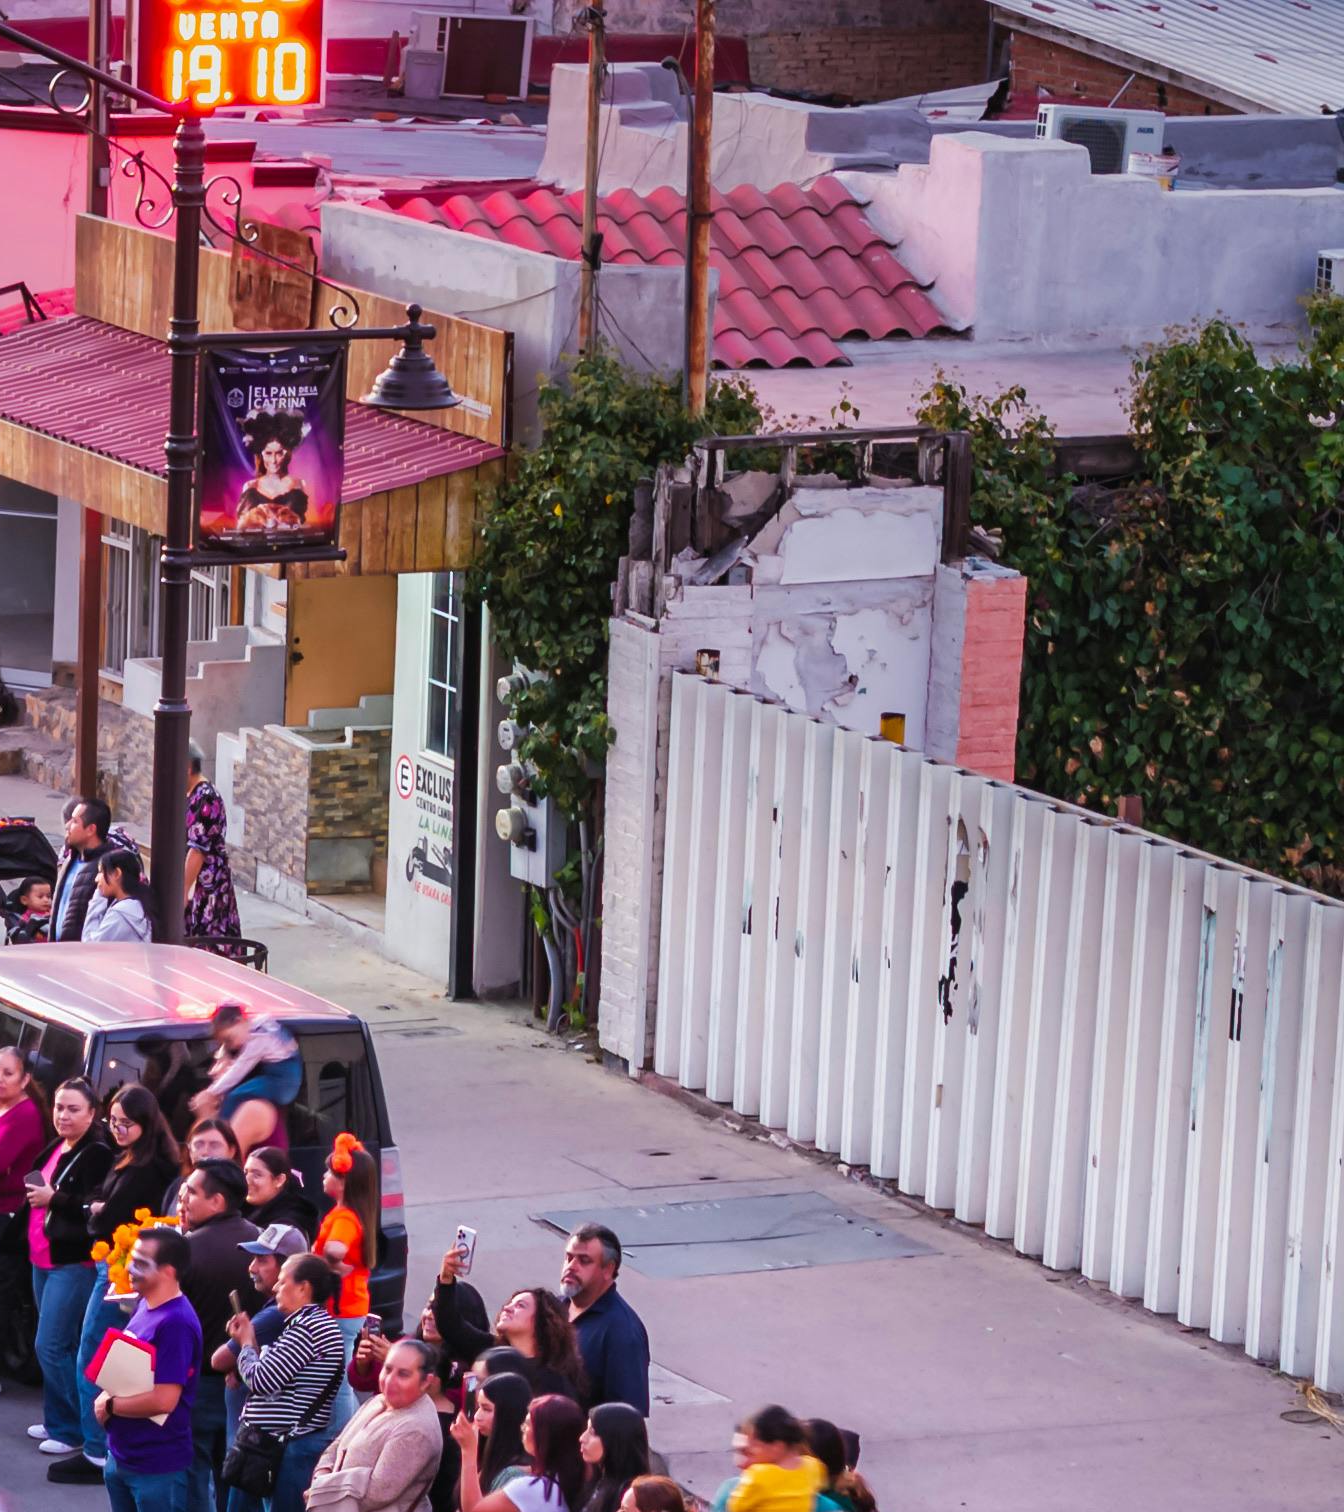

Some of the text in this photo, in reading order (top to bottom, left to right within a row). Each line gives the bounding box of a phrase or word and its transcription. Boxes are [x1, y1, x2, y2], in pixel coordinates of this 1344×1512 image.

[179, 10, 279, 41] VENTA
[254, 386, 268, 397] EL
[271, 386, 296, 397] PAN
[309, 385, 318, 393] LA
[253, 397, 307, 409] CATRINA
[400, 763, 451, 804] E EXCLUS
[415, 797, 437, 815] CENTRO
[418, 815, 430, 832] LA
